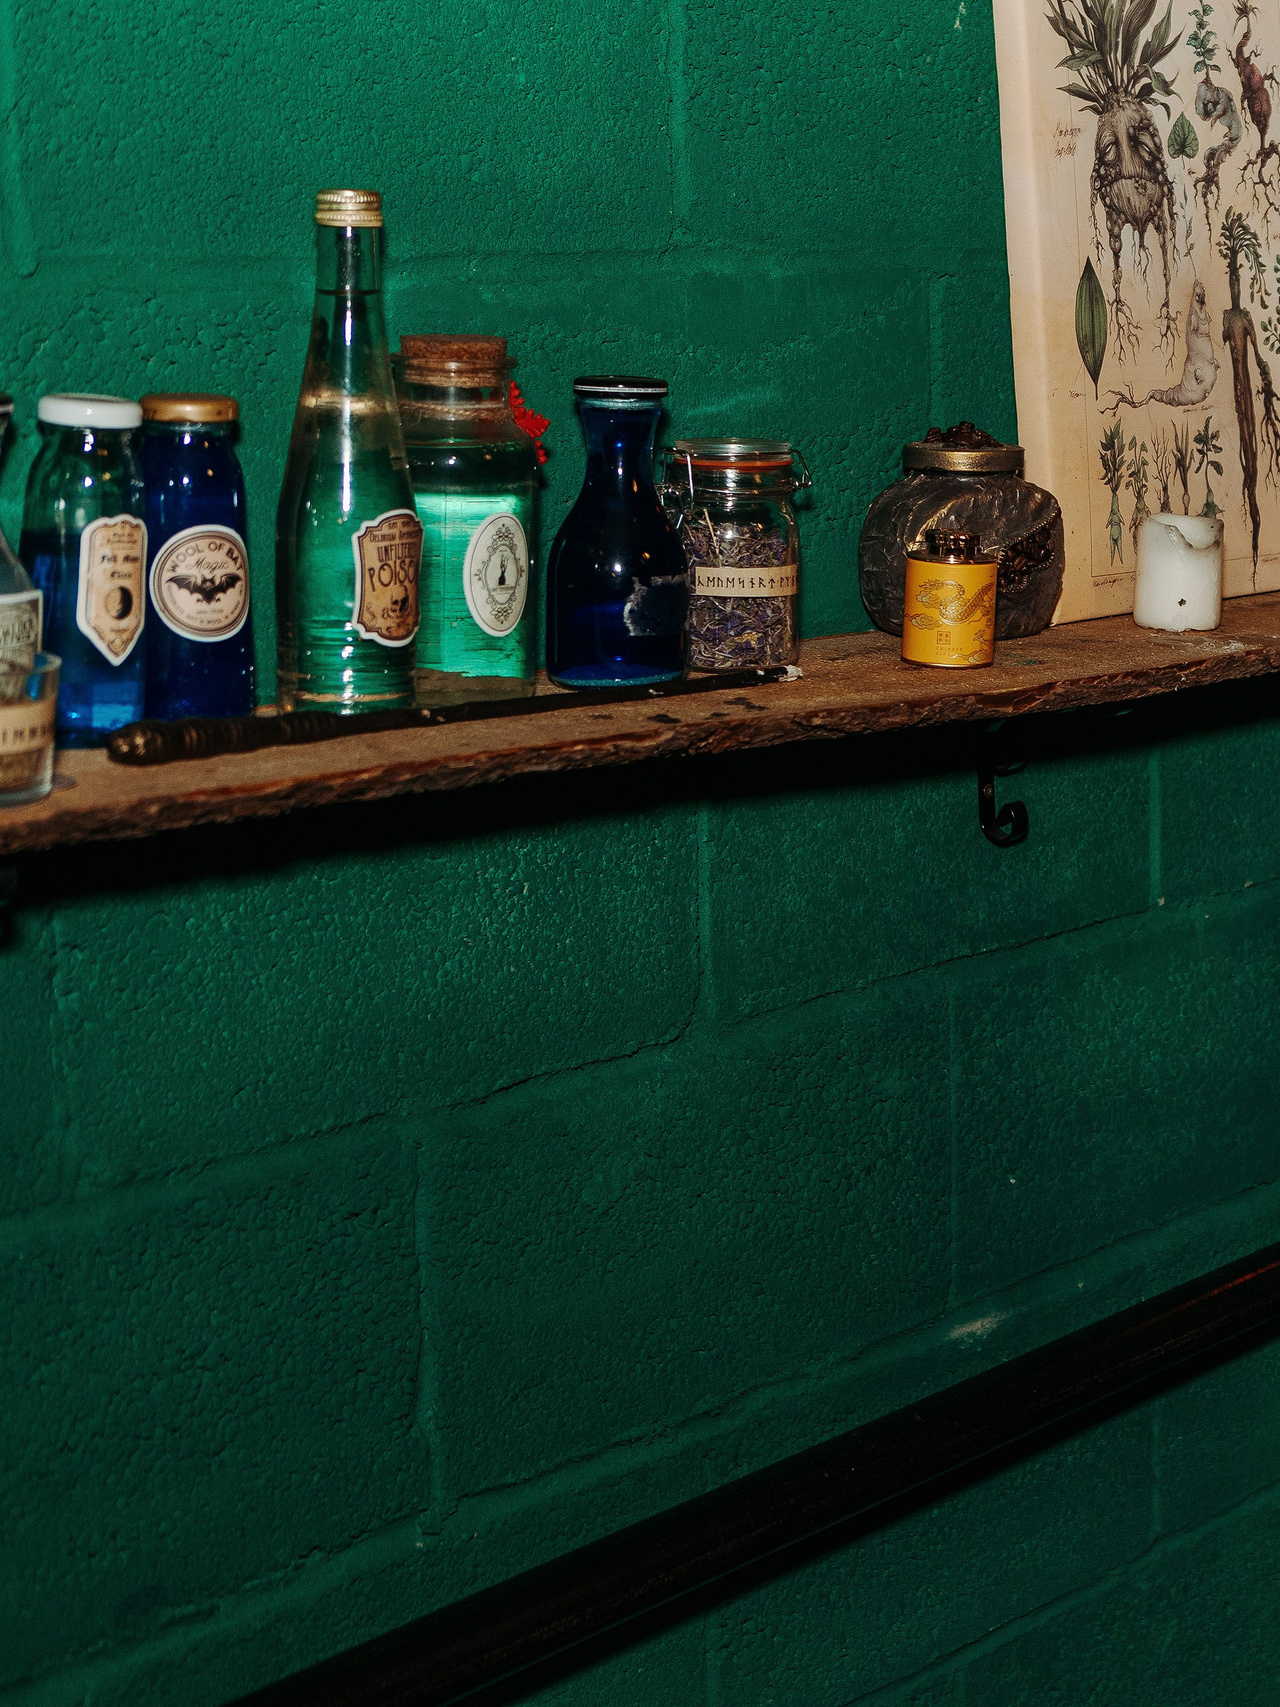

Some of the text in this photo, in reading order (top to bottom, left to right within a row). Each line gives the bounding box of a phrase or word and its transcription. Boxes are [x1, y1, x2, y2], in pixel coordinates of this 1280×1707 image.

[167, 541, 244, 573] WOOL OF BAT
[186, 556, 229, 574] Magic
[368, 558, 417, 592] POISO
